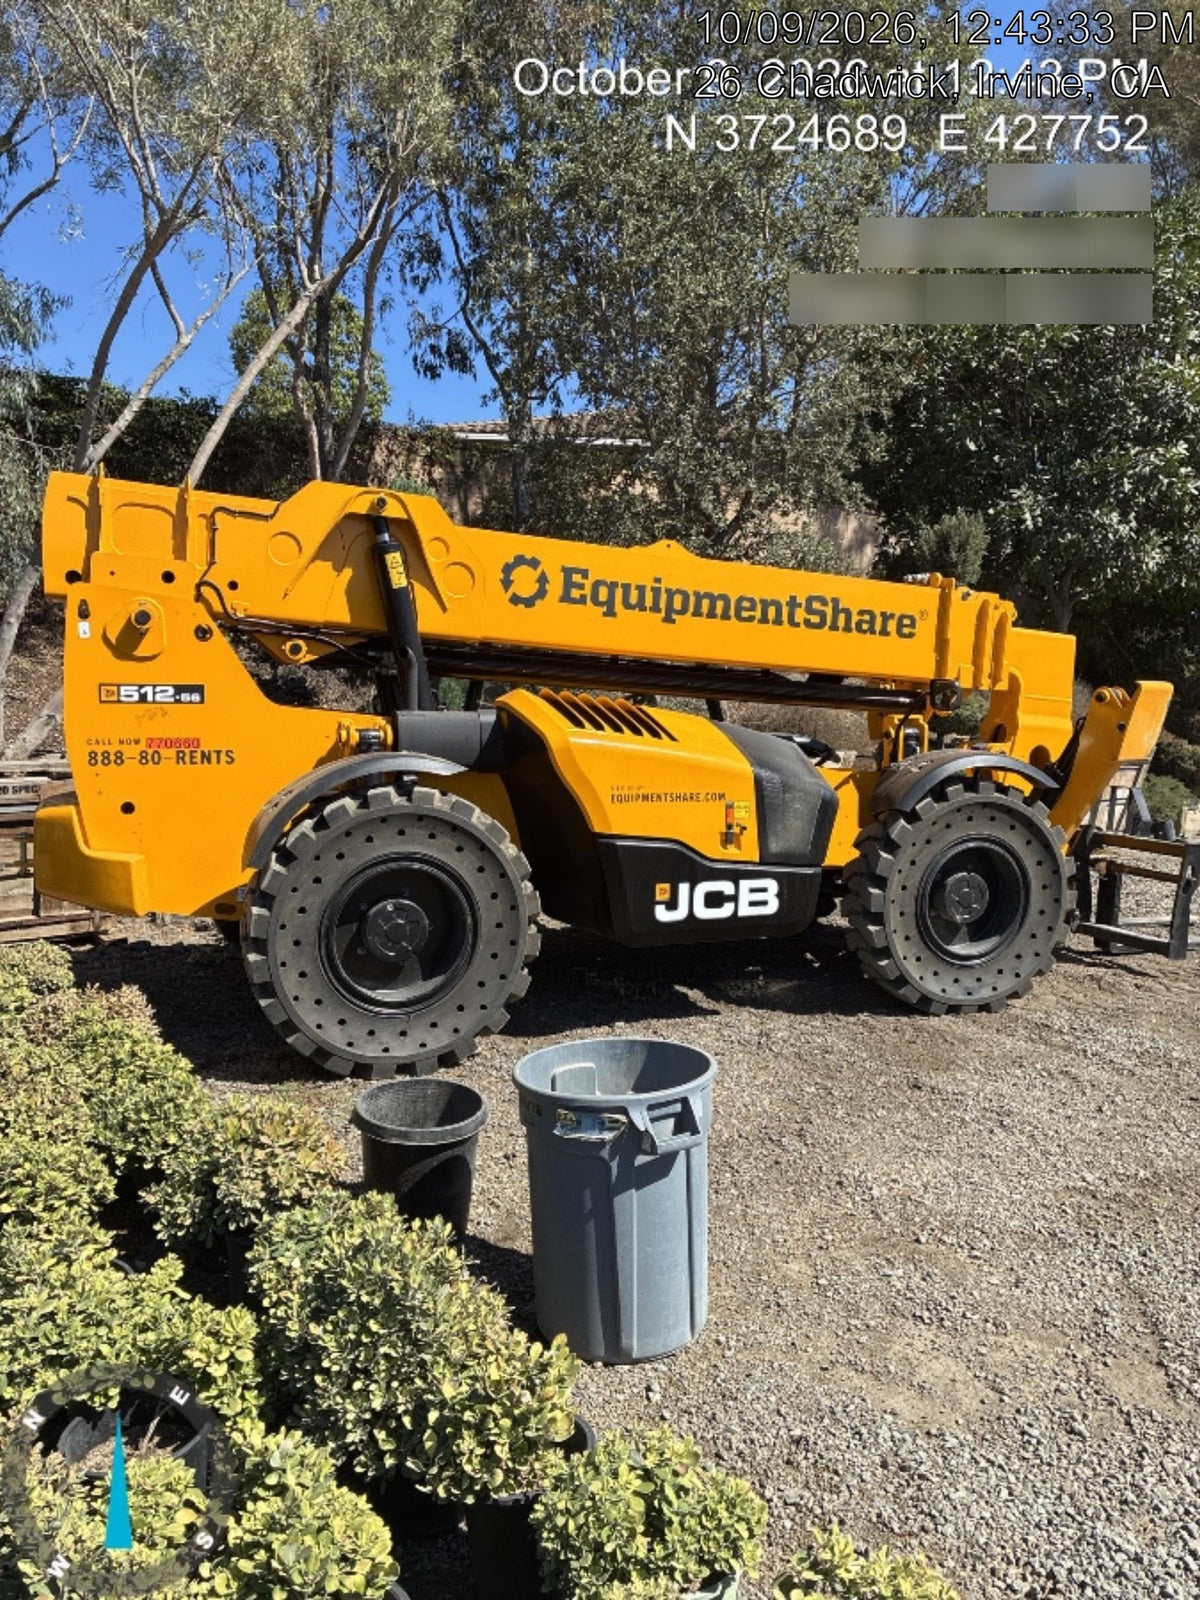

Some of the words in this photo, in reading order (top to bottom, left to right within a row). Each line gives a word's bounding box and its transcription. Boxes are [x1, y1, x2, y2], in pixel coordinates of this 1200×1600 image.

[559, 565, 917, 639] EquipmentShare
[86, 738, 113, 746] CALL
[118, 738, 141, 746] NOW
[87, 749, 235, 767] 888-80-RENTS
[611, 792, 726, 804] EQUIPMENTSHARE.COM
[654, 877, 780, 923] JCB
